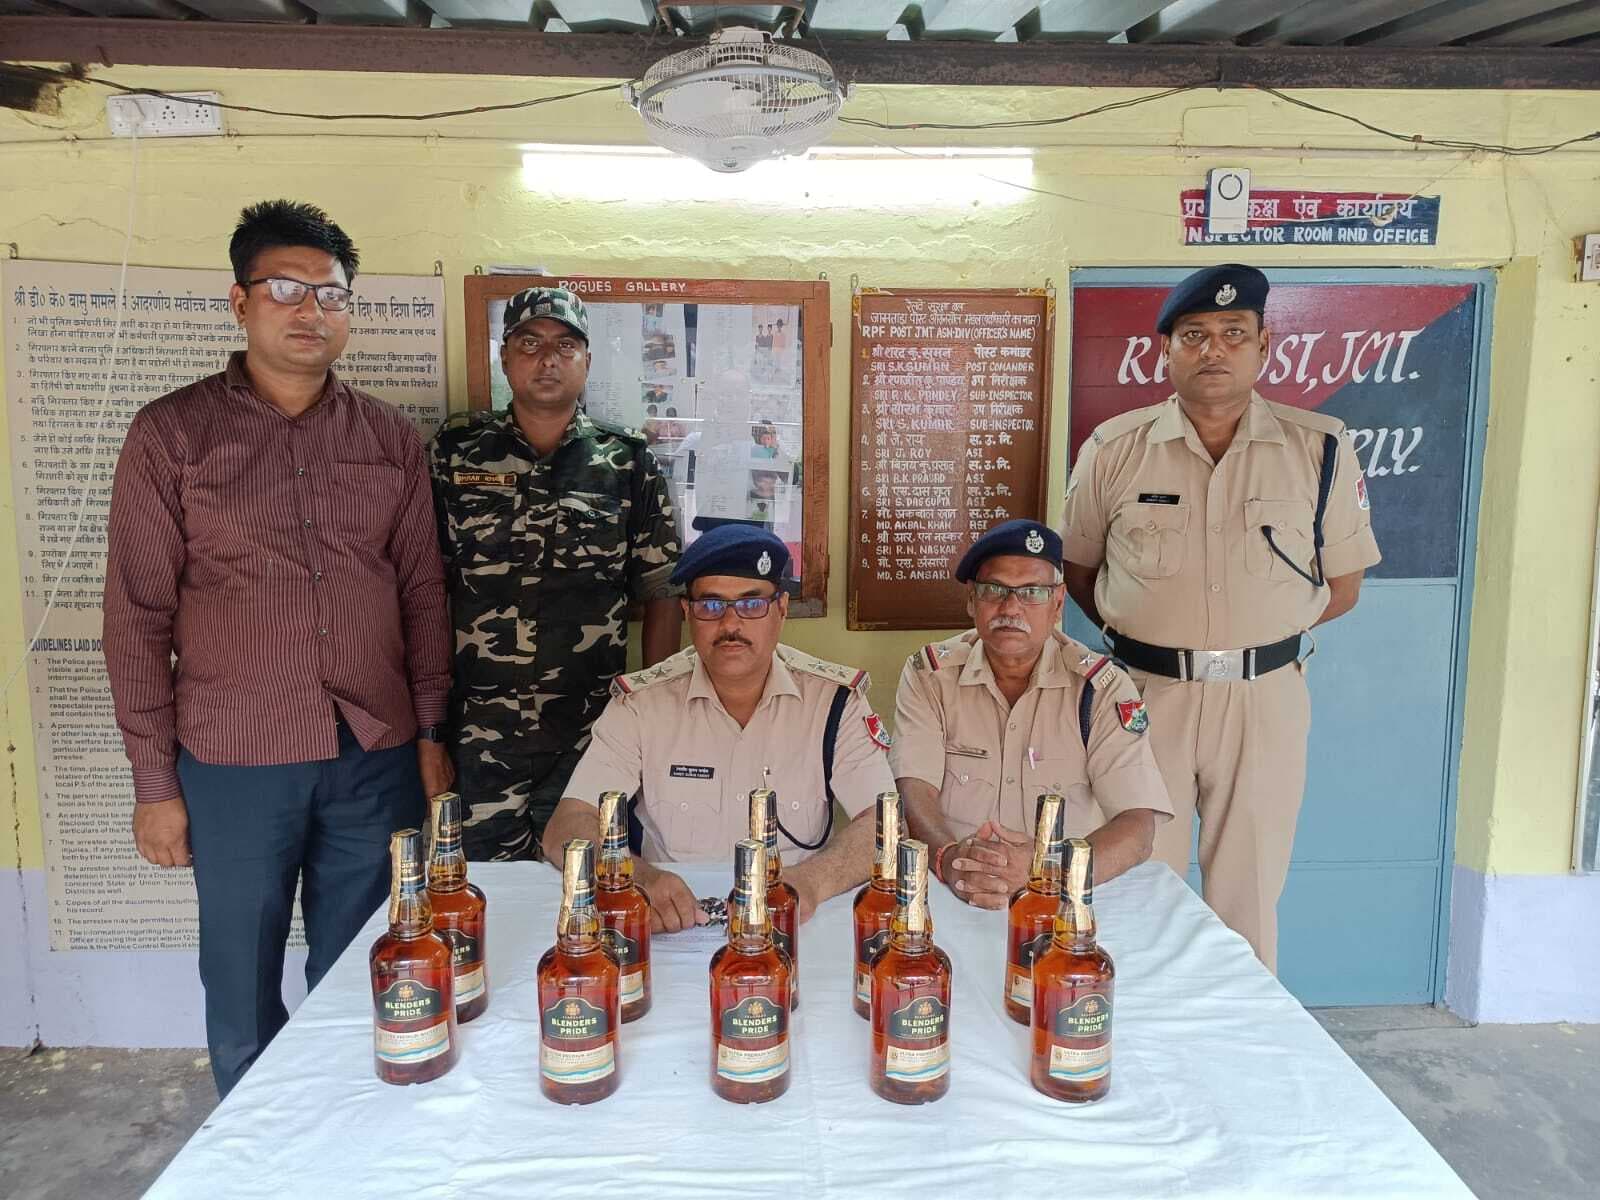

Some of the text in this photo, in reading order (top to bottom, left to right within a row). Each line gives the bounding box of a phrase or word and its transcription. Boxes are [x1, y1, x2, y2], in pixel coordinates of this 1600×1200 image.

[1294, 227, 1333, 242] ROOM
[1338, 228, 1367, 243] AND
[1373, 229, 1428, 243] OFFICE
[558, 280, 686, 293] ROGUES GALLERY
[390, 296, 409, 318] दिशा
[862, 325, 886, 338] RPF
[890, 326, 913, 338] POST
[915, 326, 935, 338] JMT
[871, 361, 886, 372] SRI
[966, 361, 988, 372] POST
[911, 418, 954, 430] KUMAR
[876, 431, 887, 446] श्री
[875, 448, 932, 458] SRI ROY
[966, 448, 983, 458] ASI
[875, 473, 945, 483] SRI PRASAD
[965, 473, 985, 483] ASI
[876, 497, 890, 507] SRI
[967, 497, 986, 507] ASI
[894, 520, 926, 530] AKBAL
[927, 520, 952, 530] KHAN
[969, 520, 988, 530] ASI
[876, 530, 889, 544] श्री
[876, 545, 892, 555] SRI
[919, 545, 957, 554] NASKAR
[909, 571, 950, 580] ANSARI
[74, 639, 90, 651] LAID
[91, 639, 102, 652] DO
[385, 998, 431, 1009] BLENDERS
[394, 1008, 422, 1016] PRIDE
[551, 1017, 597, 1027] BLENDERS
[732, 1015, 777, 1026] BLENDERS
[902, 1014, 944, 1027] BLENDERS
[1068, 1013, 1109, 1025] BLENDERS
[560, 1027, 588, 1035] PRIDE
[742, 1025, 769, 1034] PRIDE
[911, 1026, 937, 1035] PRIDE
[1078, 1023, 1103, 1033] PRIDE
